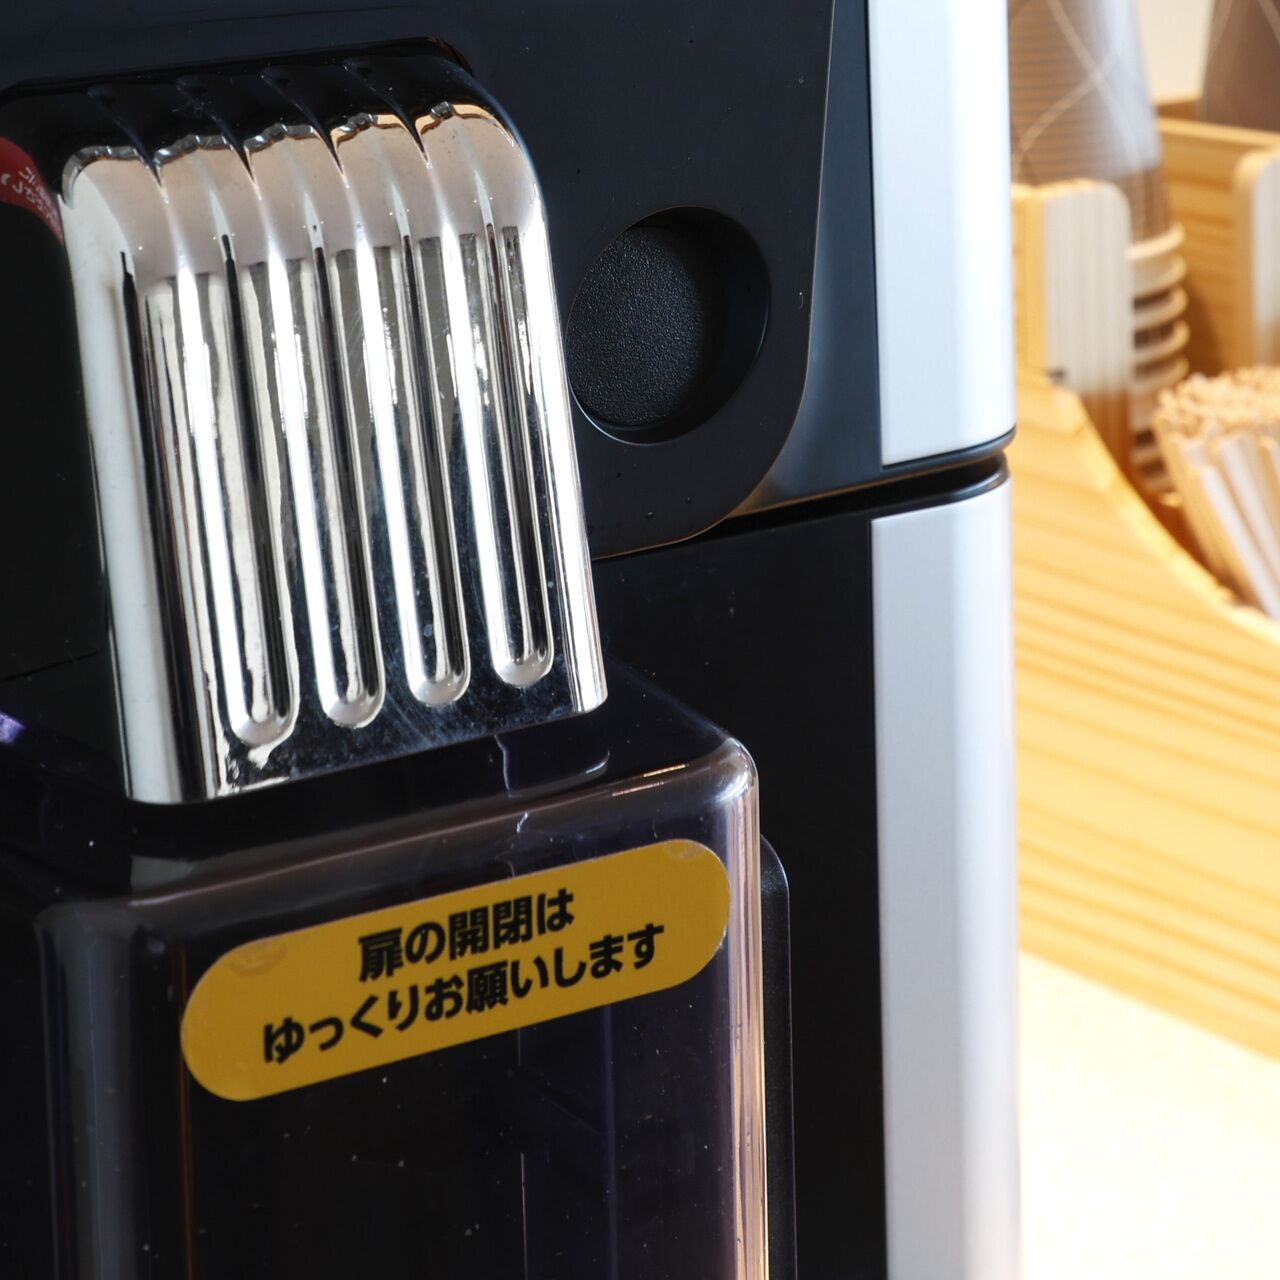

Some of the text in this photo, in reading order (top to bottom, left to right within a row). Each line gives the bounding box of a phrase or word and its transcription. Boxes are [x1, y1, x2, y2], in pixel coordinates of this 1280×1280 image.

[262, 923, 665, 1064] ゆっくりお願いします
[358, 888, 575, 982] 扉の開閉は
